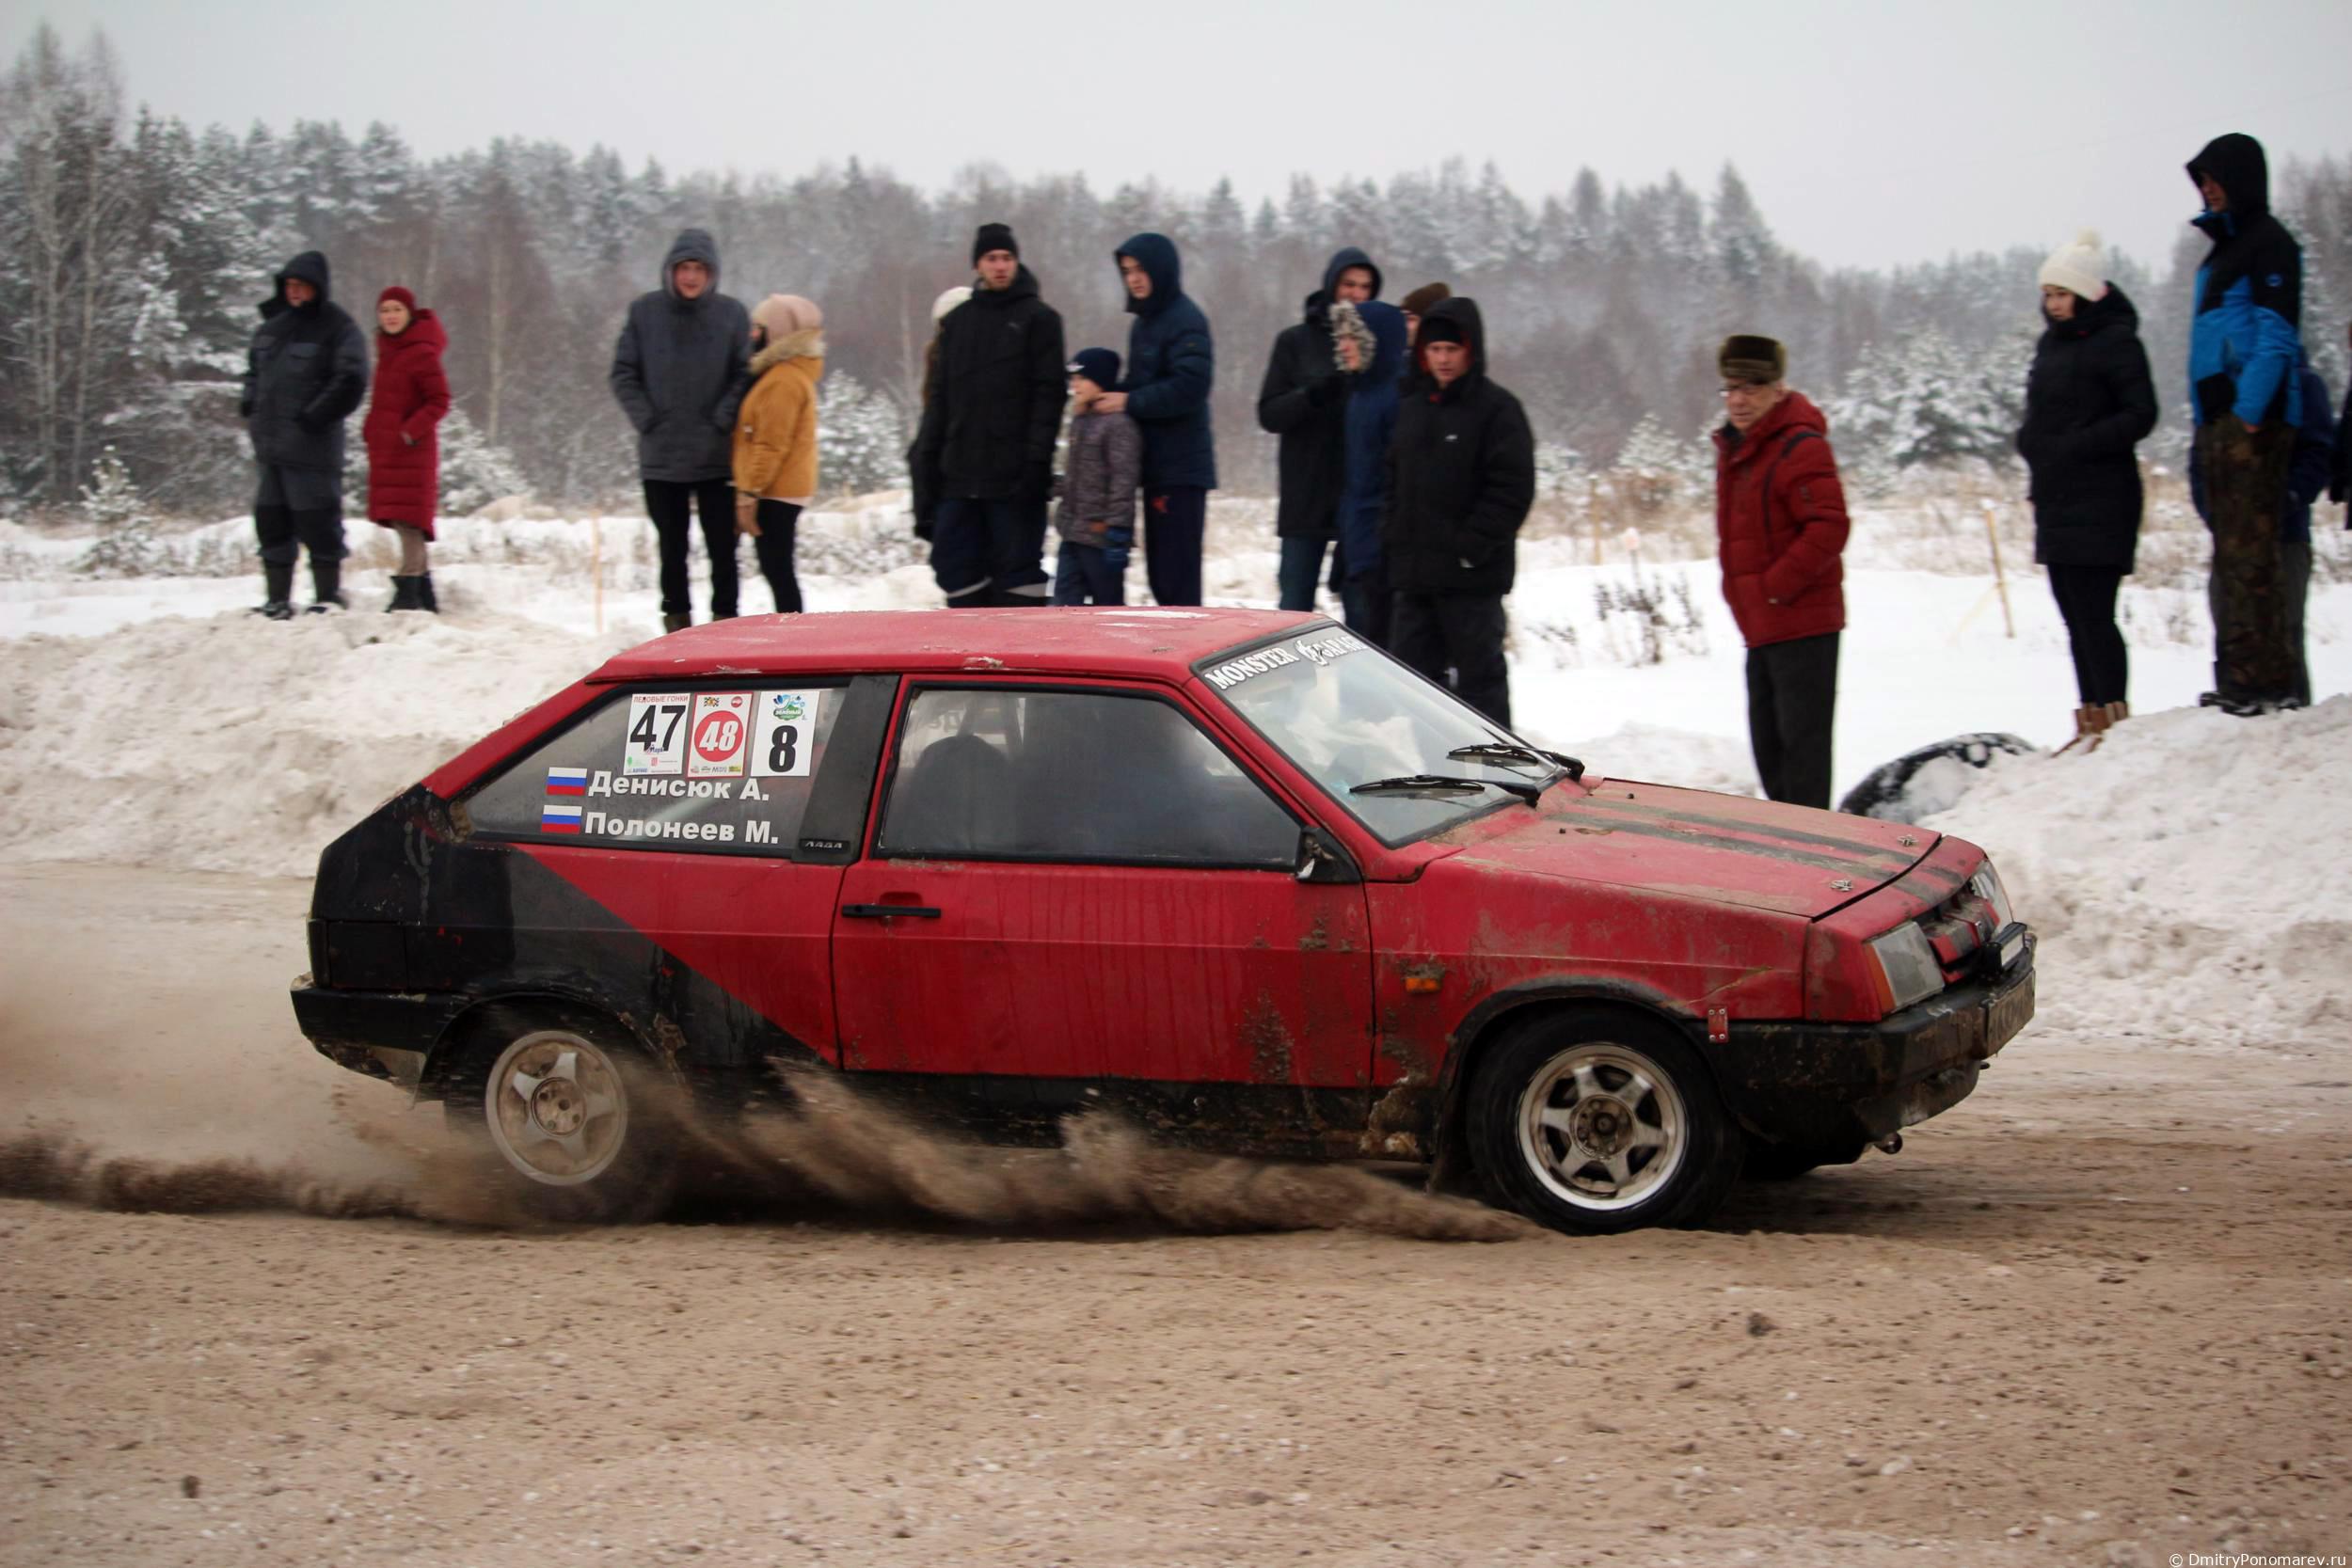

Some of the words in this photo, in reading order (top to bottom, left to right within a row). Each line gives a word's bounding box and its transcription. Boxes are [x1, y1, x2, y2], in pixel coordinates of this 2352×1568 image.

[1204, 647, 1299, 689] MONSTER
[629, 705, 687, 752] 47
[699, 721, 739, 752] 48
[769, 725, 798, 772] 8
[588, 770, 731, 800] Денисюк
[739, 778, 770, 801] А.
[584, 812, 735, 841] Полонеев
[745, 820, 779, 845] М.
